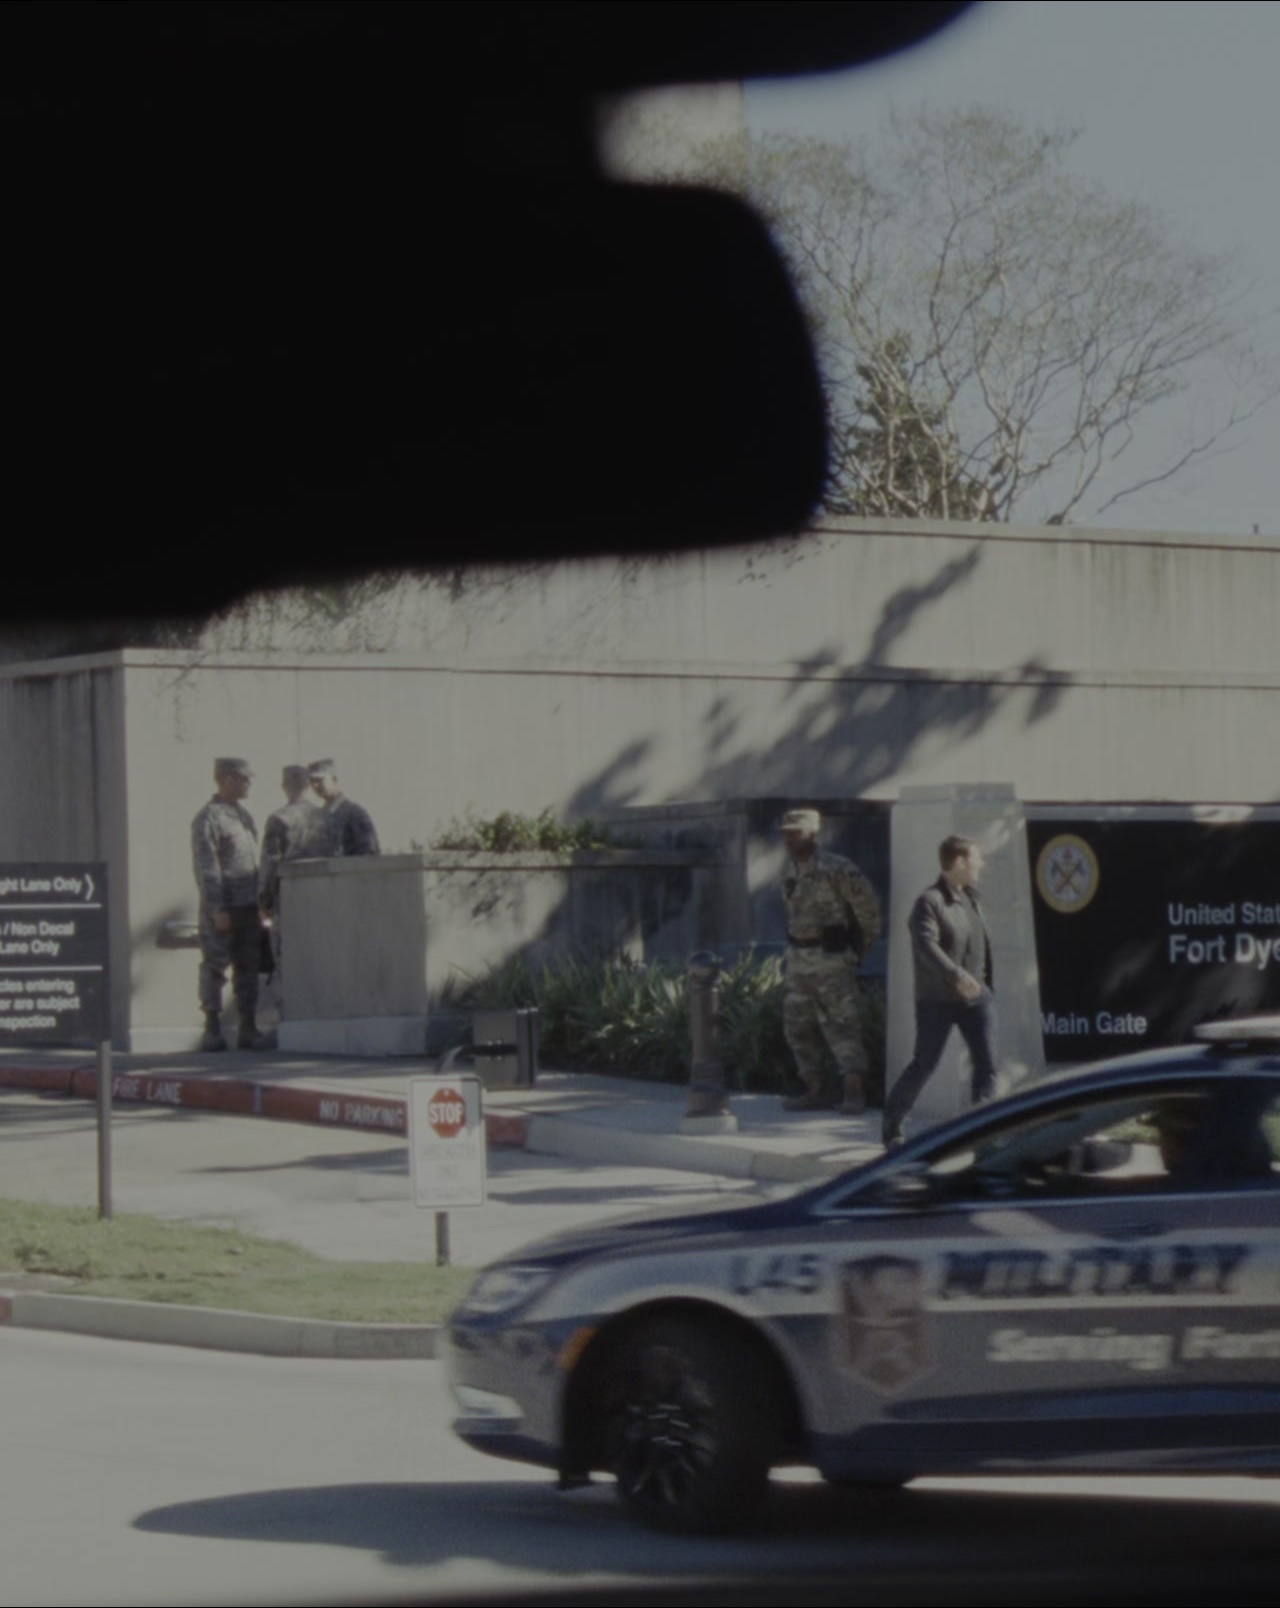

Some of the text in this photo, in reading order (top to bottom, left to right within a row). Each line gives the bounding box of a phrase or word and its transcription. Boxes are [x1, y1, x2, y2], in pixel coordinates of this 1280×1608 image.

[20, 878, 51, 892] Lane
[53, 877, 82, 894] Only
[1168, 903, 1235, 926] United
[11, 922, 37, 936] Non
[39, 921, 75, 936] Decal
[31, 939, 60, 957] Only
[1169, 933, 1226, 965] Fort
[26, 979, 75, 995] entering
[37, 996, 80, 1013] subject
[1039, 1012, 1147, 1035] Main Gate
[146, 1080, 182, 1104] LANE
[319, 1099, 404, 1128] NO PARKING
[429, 1101, 464, 1124] STOP
[937, 1242, 1243, 1299] MILITARY
[986, 1326, 1175, 1370] Serving
